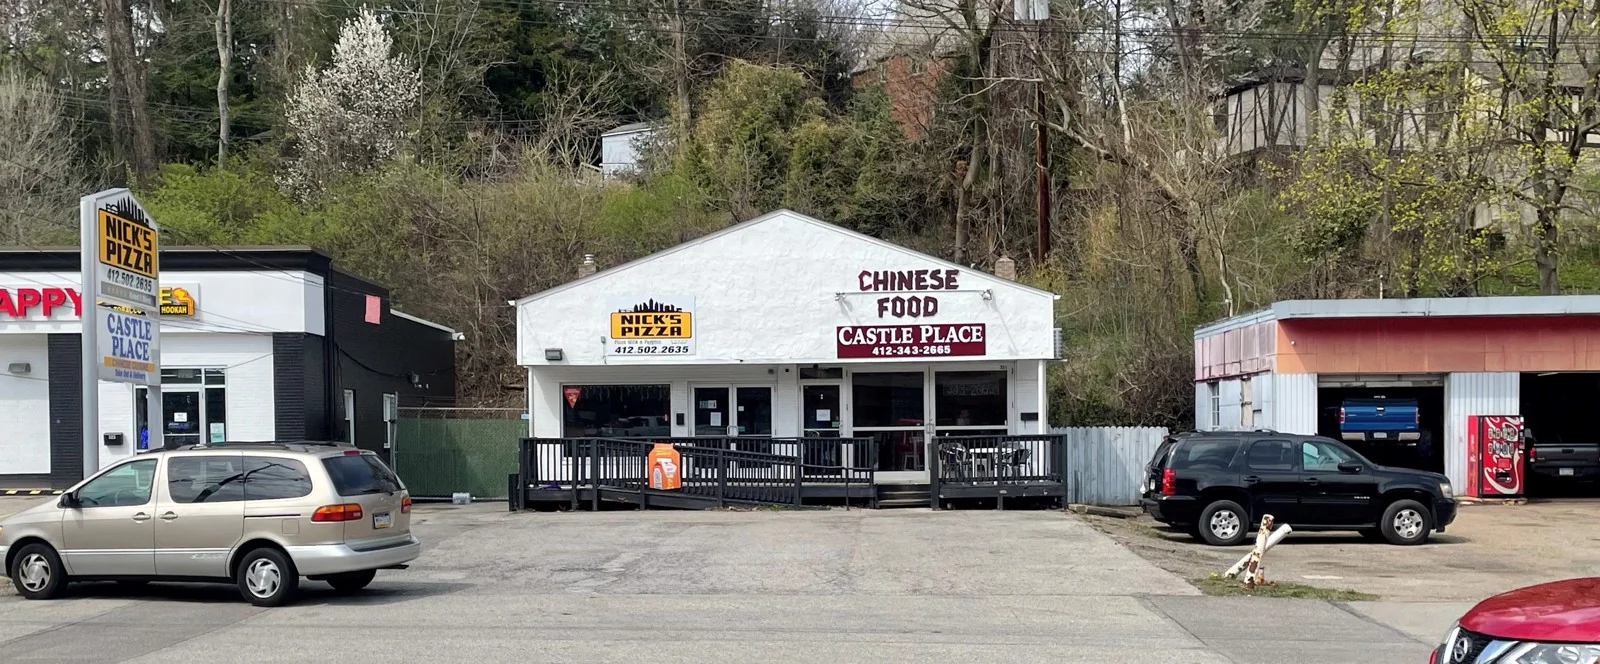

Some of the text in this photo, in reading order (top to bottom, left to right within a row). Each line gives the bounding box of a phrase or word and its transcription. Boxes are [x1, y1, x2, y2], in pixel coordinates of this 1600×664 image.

[106, 215, 151, 251] NICK'S
[107, 239, 152, 274] PIZZA
[107, 268, 152, 292] 412.502.2635
[858, 269, 959, 291] CHINESE
[161, 306, 187, 314] HOOKAH
[877, 295, 938, 318] FOOD
[107, 313, 152, 341] CASTLE
[621, 314, 682, 325] NICK'S
[621, 326, 682, 337] PIZZA
[838, 325, 983, 345] CASTLE PLACE
[112, 335, 149, 361] PLACE
[614, 346, 689, 354] 412.502.2635
[872, 345, 951, 355] 412-343-2665
